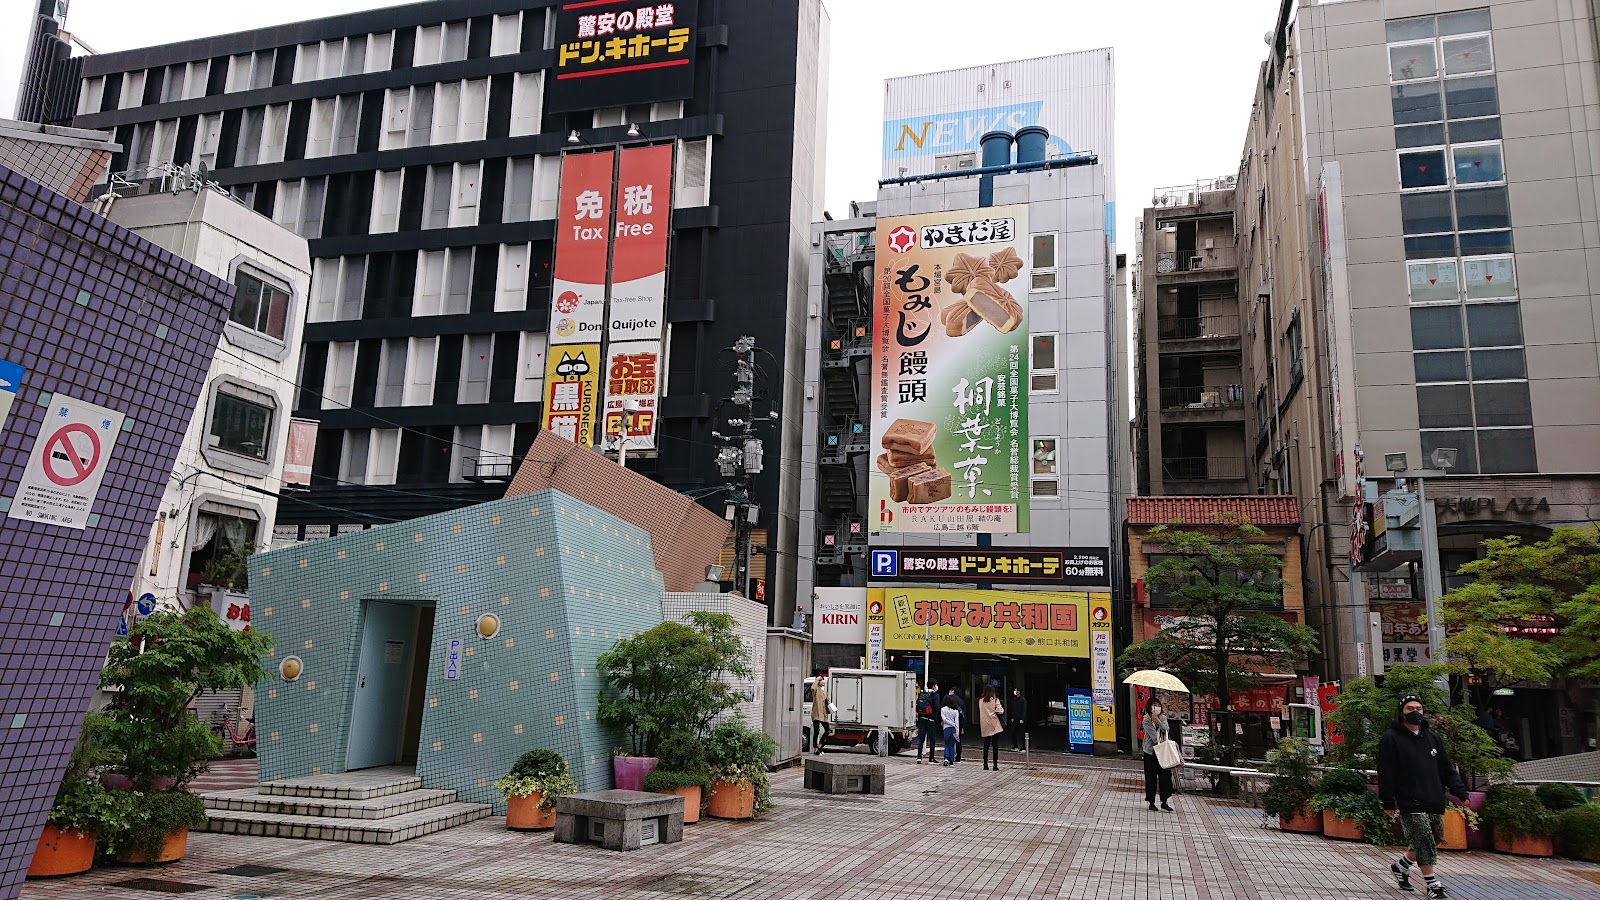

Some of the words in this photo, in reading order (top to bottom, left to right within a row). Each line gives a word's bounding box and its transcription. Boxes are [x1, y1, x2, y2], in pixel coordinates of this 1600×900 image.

[577, 4, 674, 38] 驚安の殿堂
[894, 109, 1027, 151] NEWS
[573, 225, 603, 241] Tax
[615, 221, 654, 238] Free
[924, 219, 1011, 247] やまだ屋
[637, 295, 652, 303] Shop
[579, 322, 602, 332] Don
[612, 319, 656, 331] Quijote
[895, 264, 932, 404] もみじ饅頭
[610, 352, 657, 379] お宝
[58, 407, 69, 418] 禁
[579, 380, 593, 445] KURONECO
[951, 376, 994, 499] 桐葉菓
[26, 509, 33, 517] NO
[36, 511, 57, 521] SMOKING
[61, 516, 73, 524] AREA
[1065, 566, 1104, 577] 60分無料
[822, 613, 858, 624] KIRIN
[913, 600, 1077, 631] お好み共和国
[447, 640, 460, 679] P出入口
